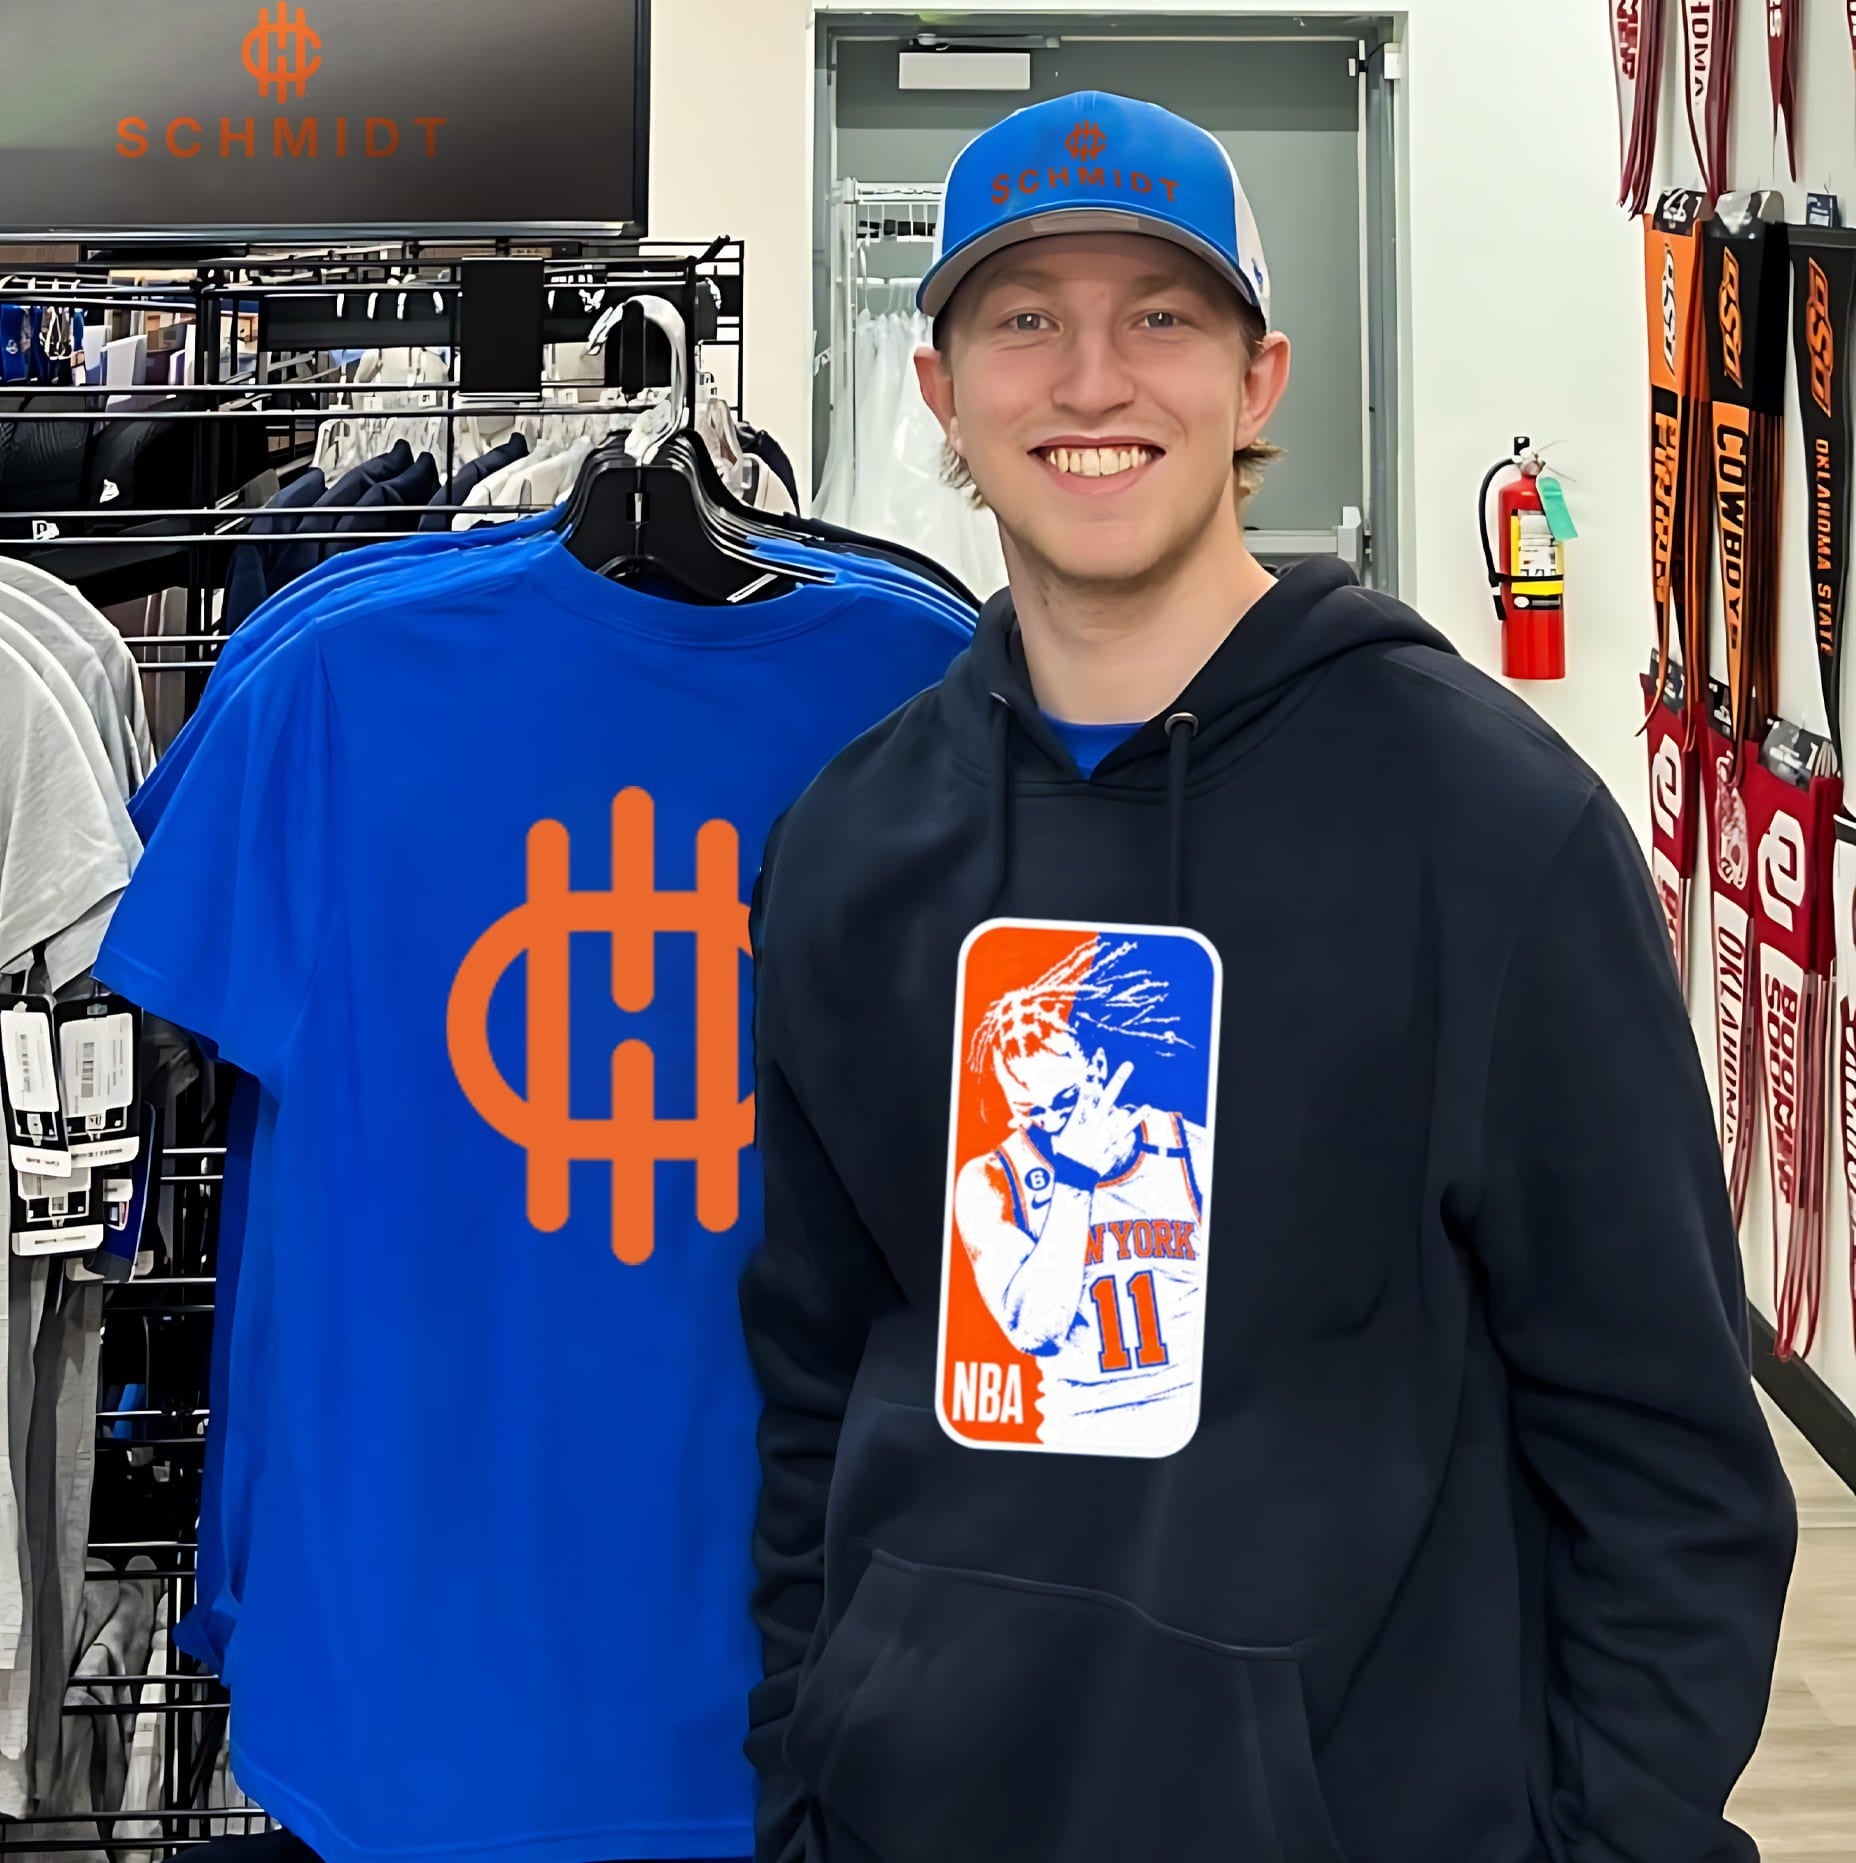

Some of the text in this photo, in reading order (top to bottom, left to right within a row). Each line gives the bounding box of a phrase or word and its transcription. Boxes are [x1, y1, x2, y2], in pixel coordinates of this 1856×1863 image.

[116, 117, 447, 158] SCHMIDT
[991, 166, 1179, 205] SCHMIDT
[1814, 438, 1833, 657] OKLAHOMA STATE
[1718, 926, 1745, 1144] OKLAHOMA
[1107, 1219, 1196, 1261] YORK
[1089, 1269, 1170, 1374] 11
[952, 1361, 1024, 1424] NBA
